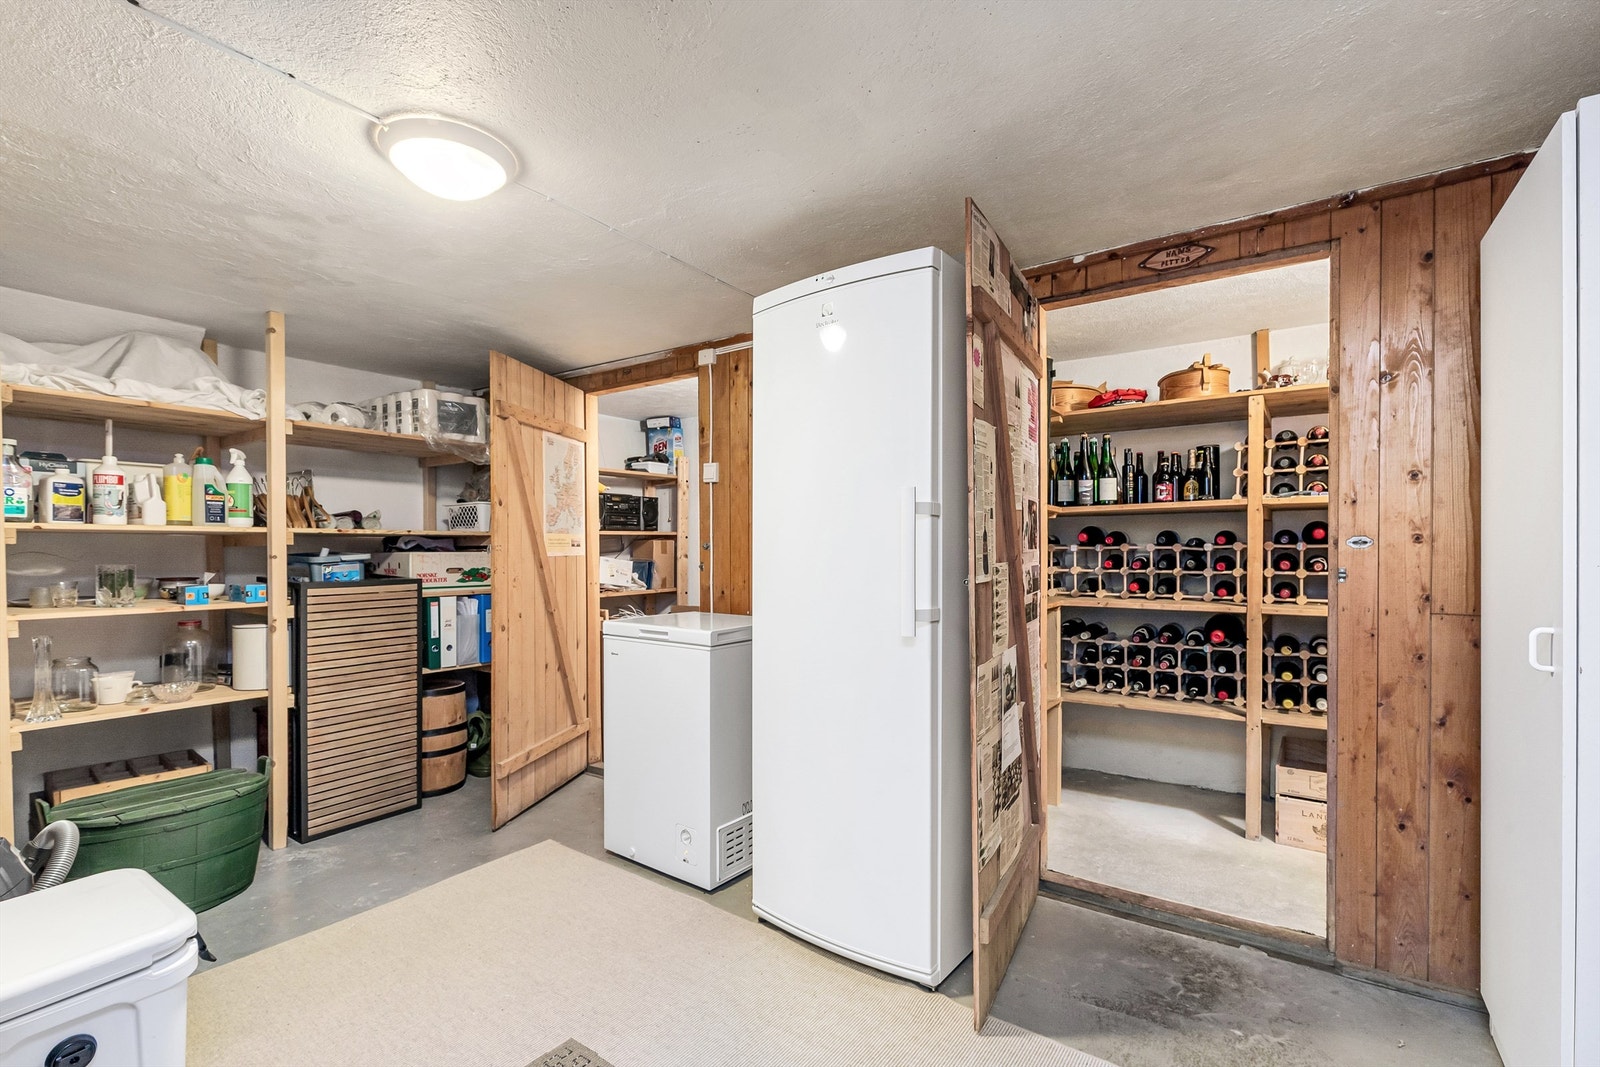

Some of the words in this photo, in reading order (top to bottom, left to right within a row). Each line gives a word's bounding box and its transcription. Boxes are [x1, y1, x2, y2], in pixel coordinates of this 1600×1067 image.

[1165, 247, 1190, 257] HANS
[1160, 256, 1190, 267] PETTER
[654, 440, 668, 453] REN
[1301, 809, 1327, 820] LAN
